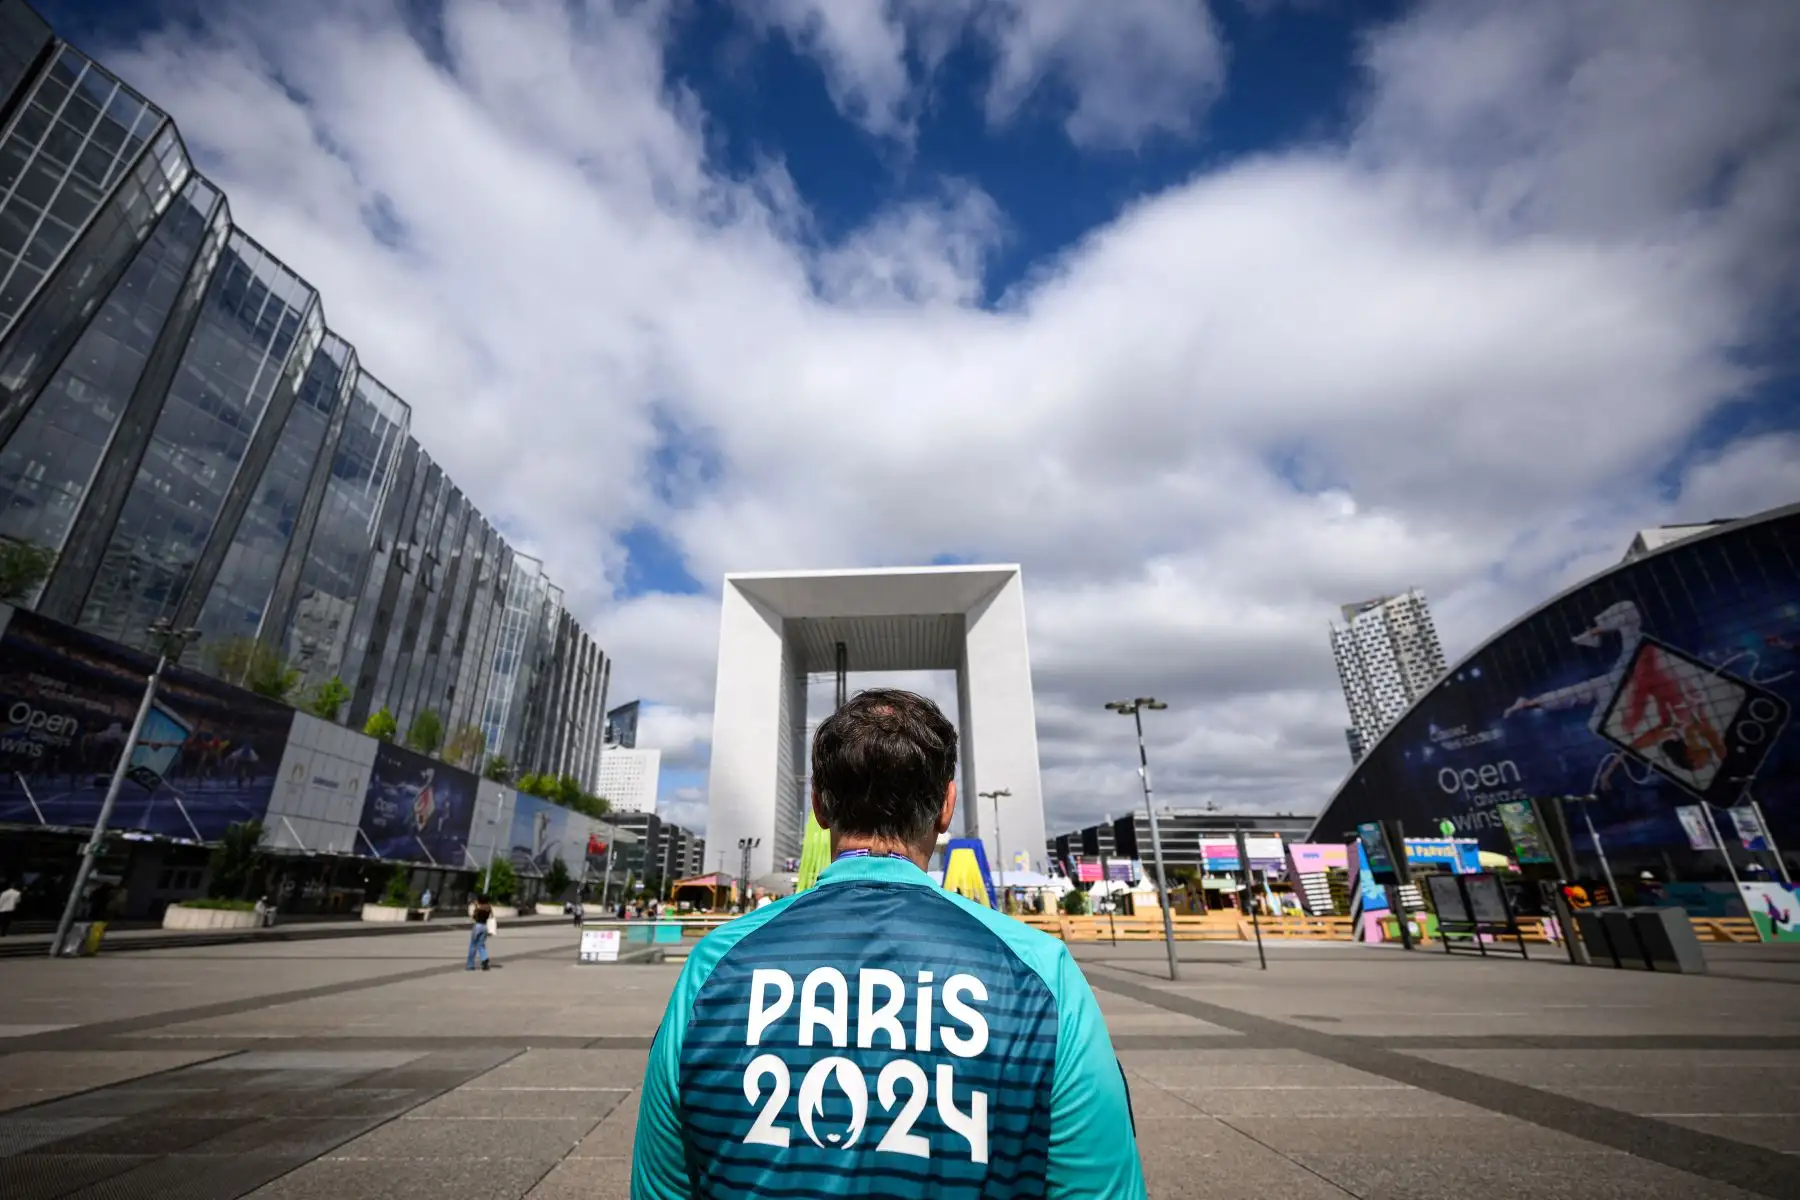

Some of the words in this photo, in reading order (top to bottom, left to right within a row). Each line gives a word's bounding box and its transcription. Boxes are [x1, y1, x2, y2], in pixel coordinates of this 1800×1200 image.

[8, 701, 79, 736] Open
[0, 737, 44, 758] wins
[1438, 760, 1521, 801] Open
[1452, 807, 1503, 832] wins
[741, 1053, 989, 1165] 2024
